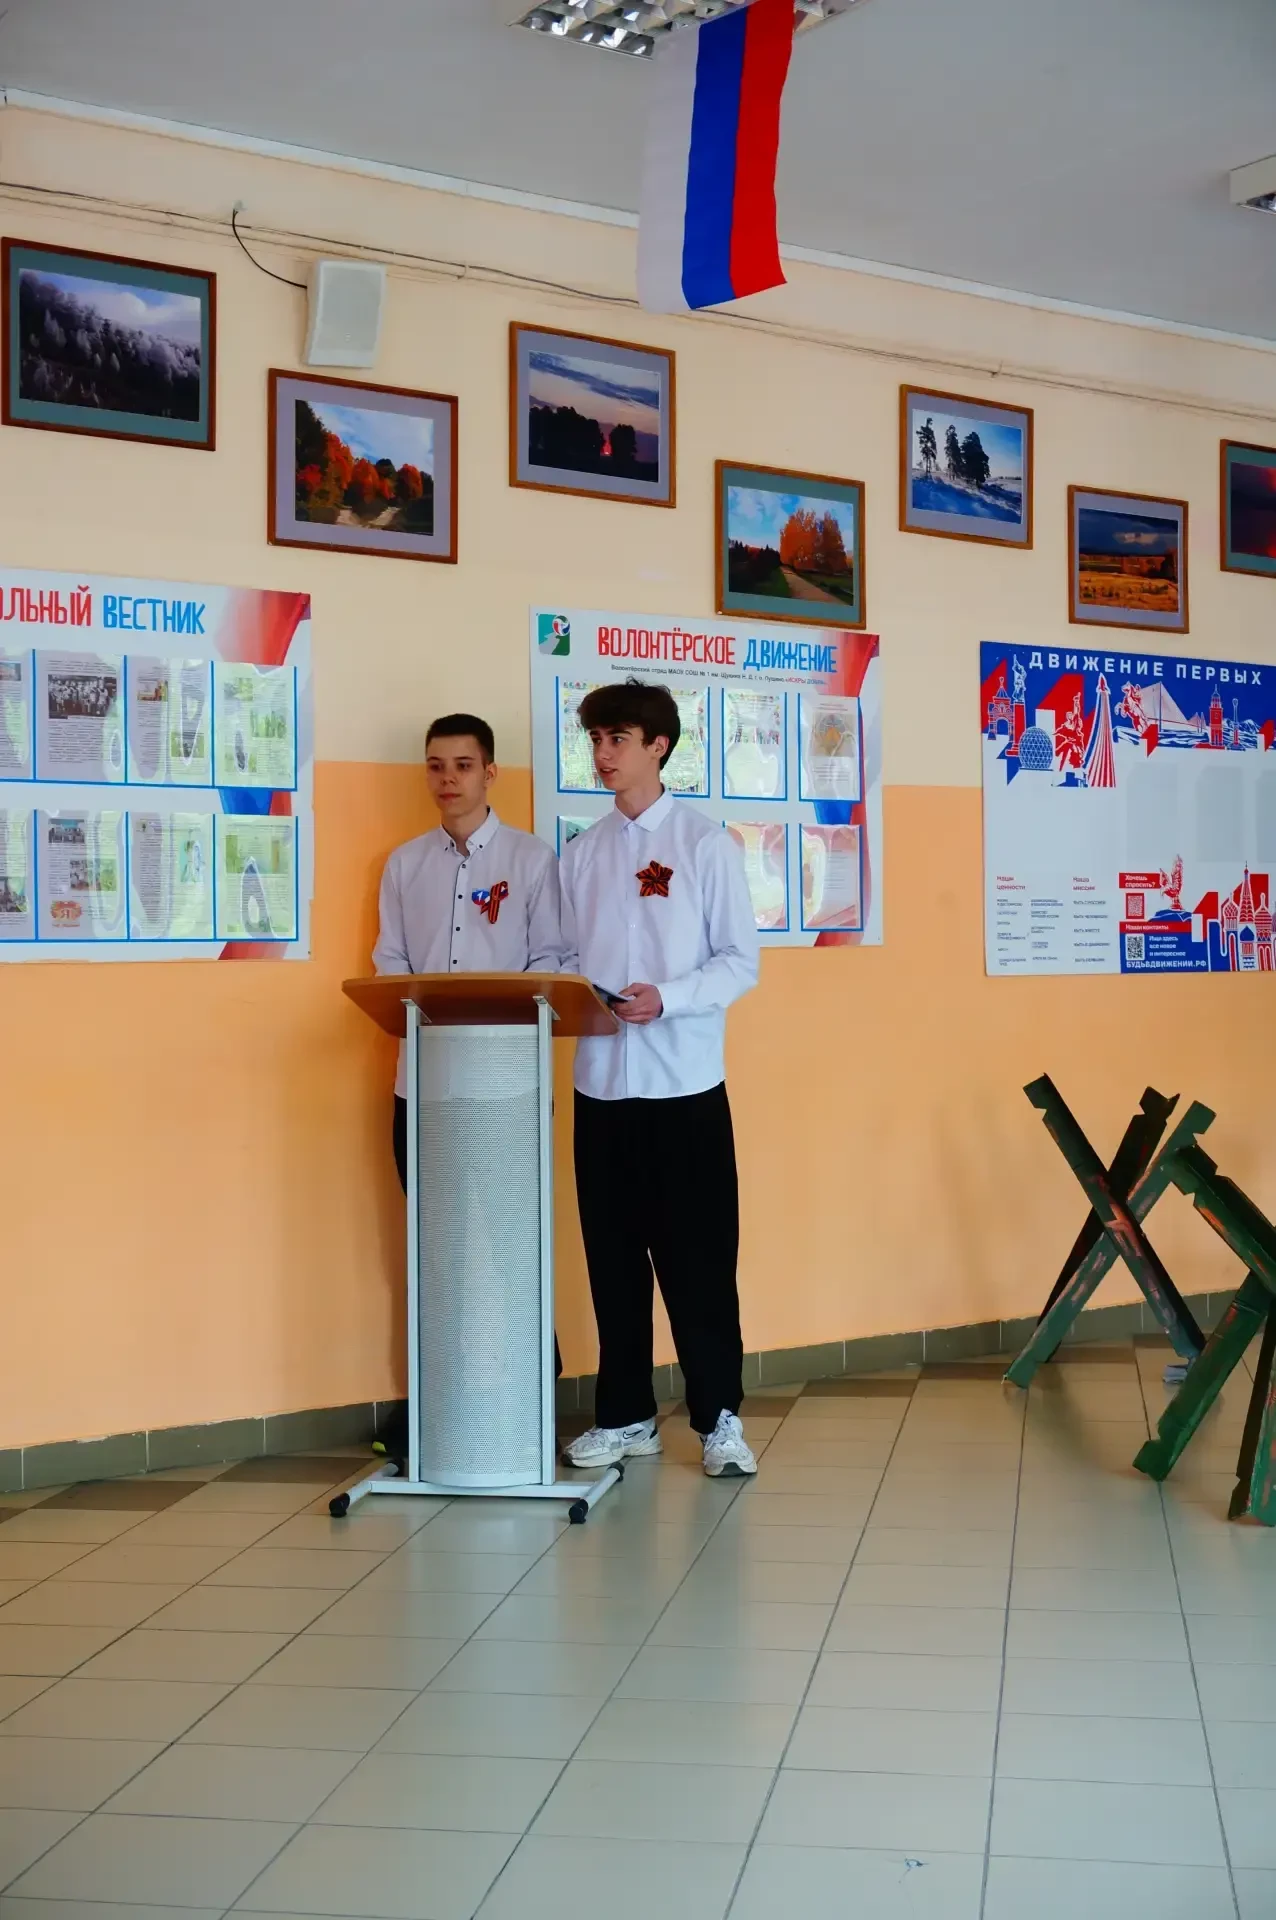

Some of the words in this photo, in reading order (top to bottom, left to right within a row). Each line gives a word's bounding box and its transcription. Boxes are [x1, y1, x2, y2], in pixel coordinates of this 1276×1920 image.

[0, 584, 92, 627] ЛЬНЫЙ
[103, 594, 206, 635] ВЕСТНИК
[598, 626, 736, 665] ВОЛОНТЁРСКОЕ
[743, 638, 838, 673] ДВИЖЕНИЕ
[1029, 651, 1164, 677] ДВИЖЕНИЕ
[1176, 663, 1262, 685] ПЕРВЫХ
